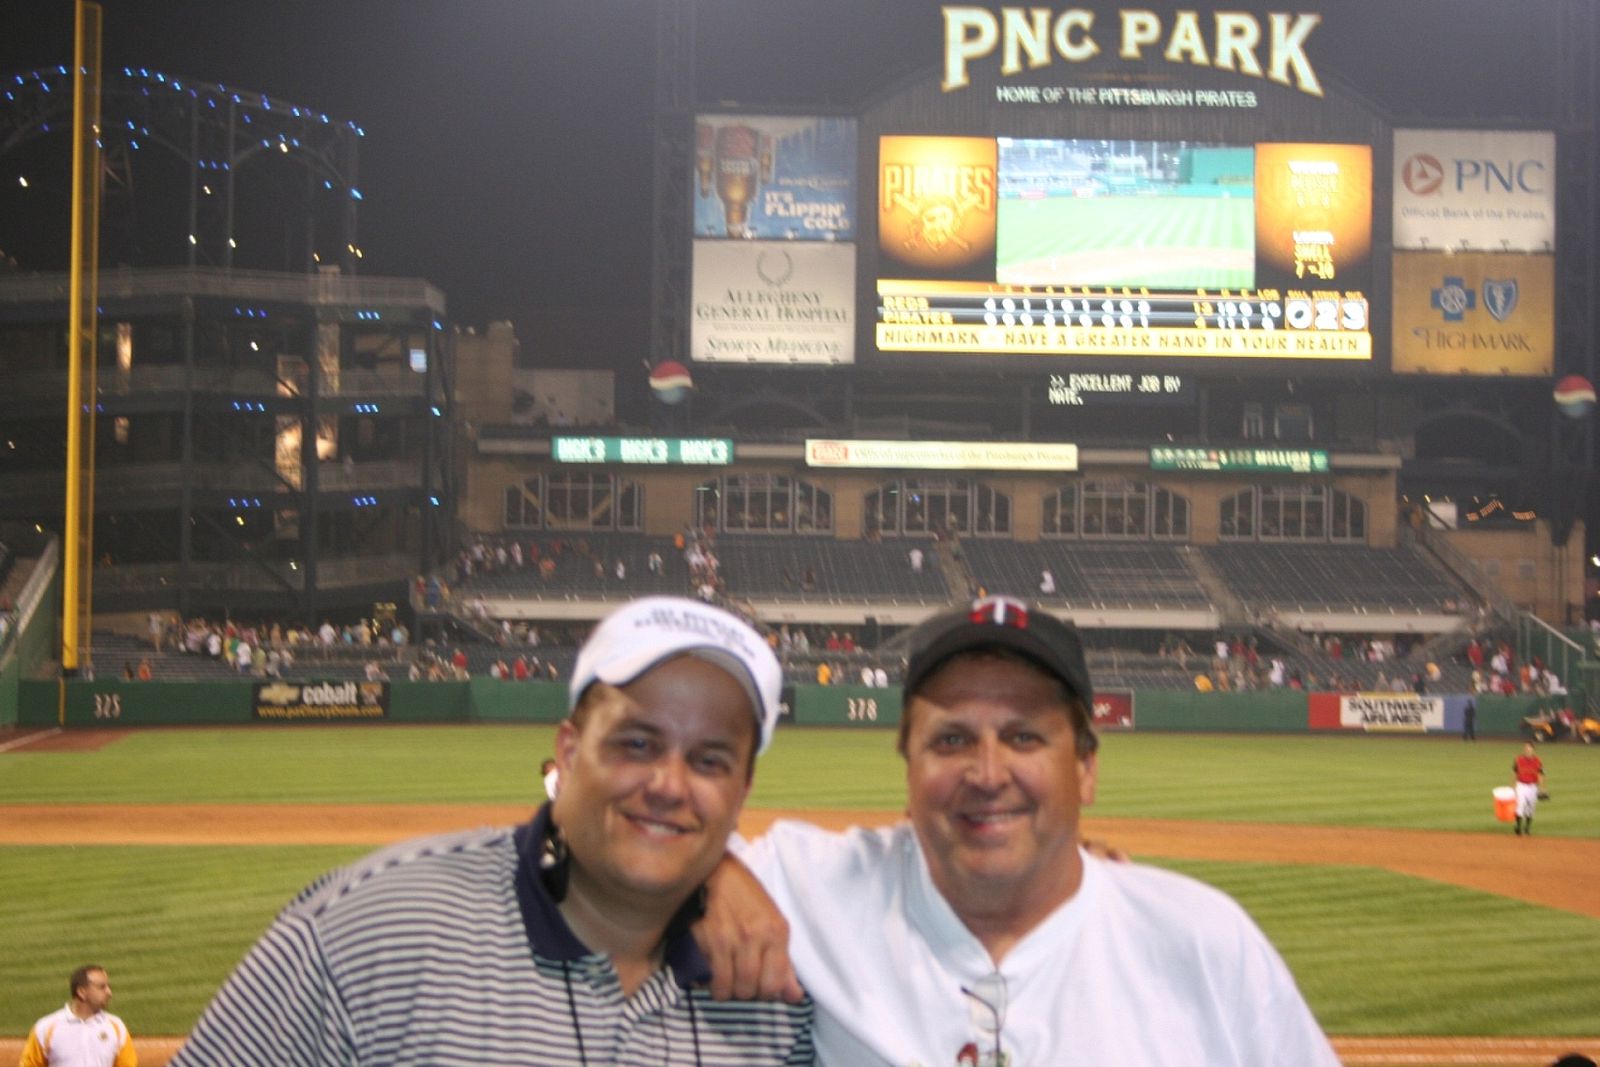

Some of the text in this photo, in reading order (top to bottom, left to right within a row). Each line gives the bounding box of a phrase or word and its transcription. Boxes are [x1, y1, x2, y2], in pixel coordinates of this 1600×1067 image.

[941, 8, 1324, 97] PNC PARK
[996, 86, 1258, 107] HOME OF THE PITTSBURGH PIRATES
[1455, 160, 1546, 193] PNC
[883, 164, 993, 211] PIRATES
[803, 216, 850, 230] COLD
[1443, 207, 1469, 218] Bank
[727, 288, 820, 305] ALLEGHENY
[696, 304, 848, 322] GENERAL HOSPITAL
[884, 330, 1358, 351] HIGHMARK HAVE A GREATER HAND IN YOUR HEALTH
[1412, 326, 1533, 353] HIGHMARK
[1069, 373, 1133, 392] EXCELLENT
[1137, 375, 1160, 392] JOB
[1164, 375, 1180, 392] BY
[303, 681, 357, 704] cobalt
[95, 694, 120, 718] 325
[1348, 698, 1437, 713] SOUTHWEST
[1361, 711, 1422, 724] AIRLINES
